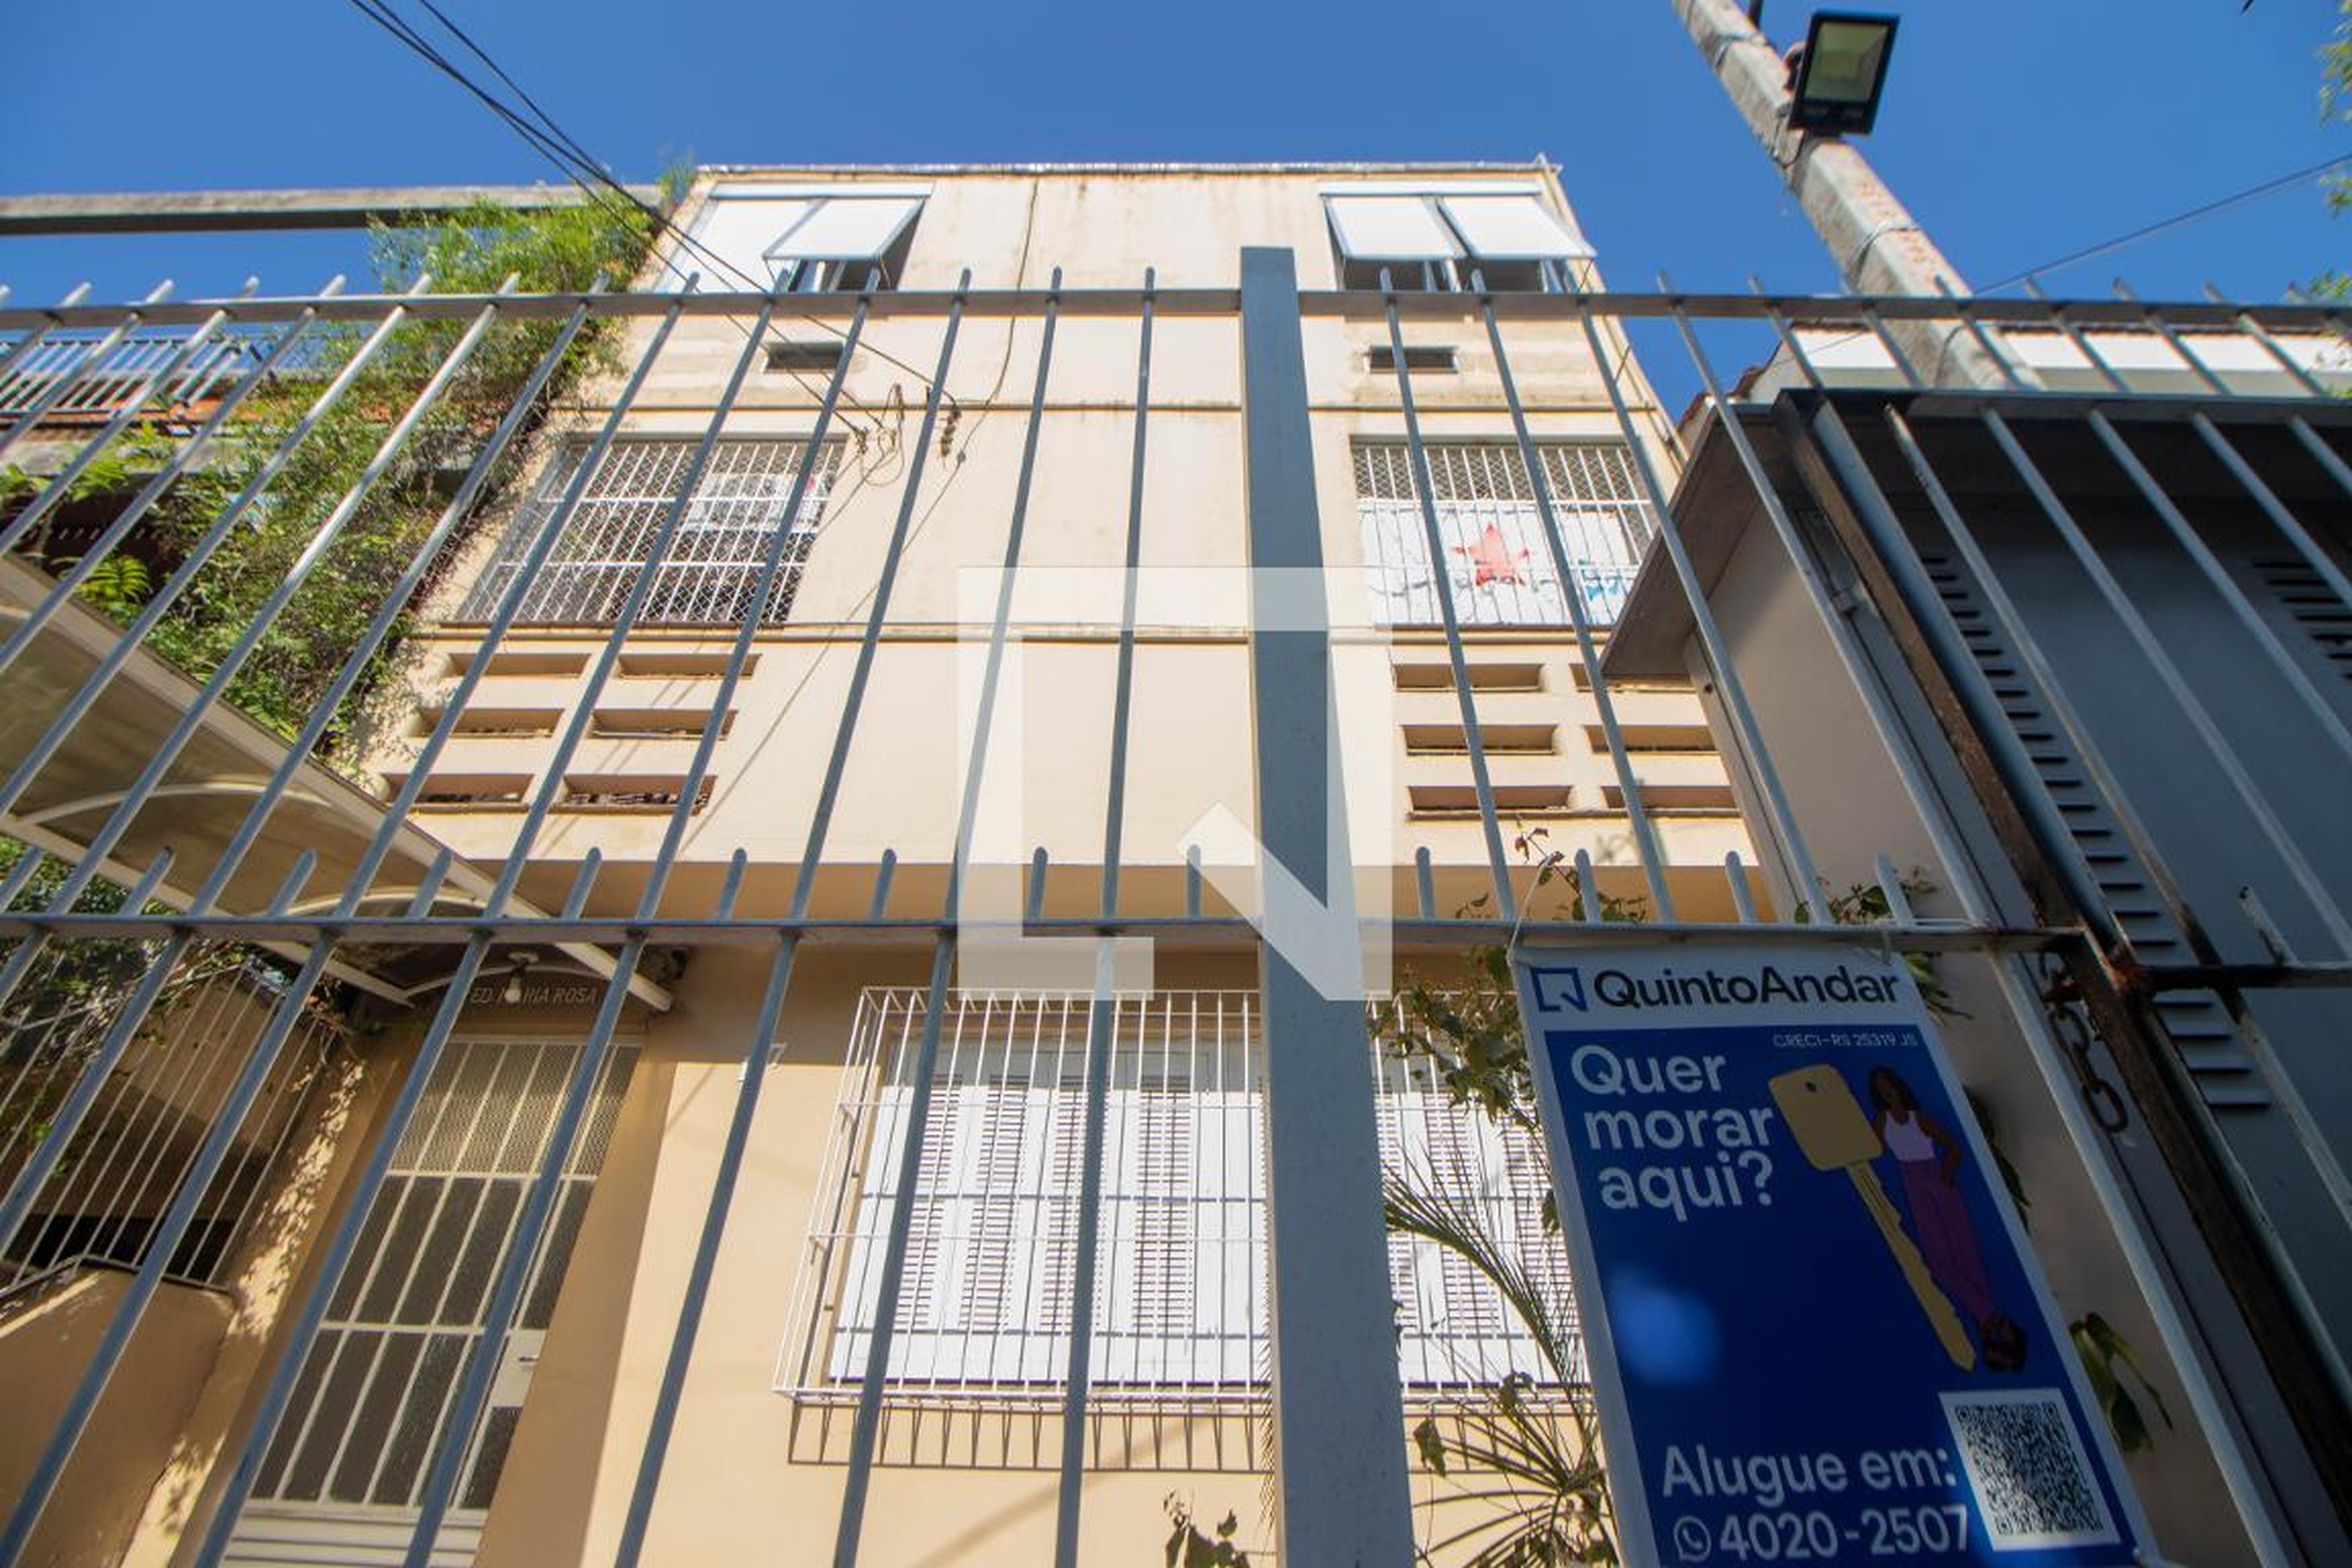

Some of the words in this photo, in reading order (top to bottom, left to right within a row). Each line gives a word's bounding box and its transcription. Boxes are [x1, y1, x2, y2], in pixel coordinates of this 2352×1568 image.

[552, 987, 598, 1004] ROSA
[1594, 965, 1899, 1009] QuintoAndar
[1570, 1044, 1726, 1095] Quer
[1583, 1107, 1774, 1150] morar
[1598, 1150, 1773, 1222] aqui?
[1663, 1444, 1848, 1508] Alugue
[1860, 1448, 1957, 1490] em:
[1720, 1504, 1969, 1561] 4020-2507
